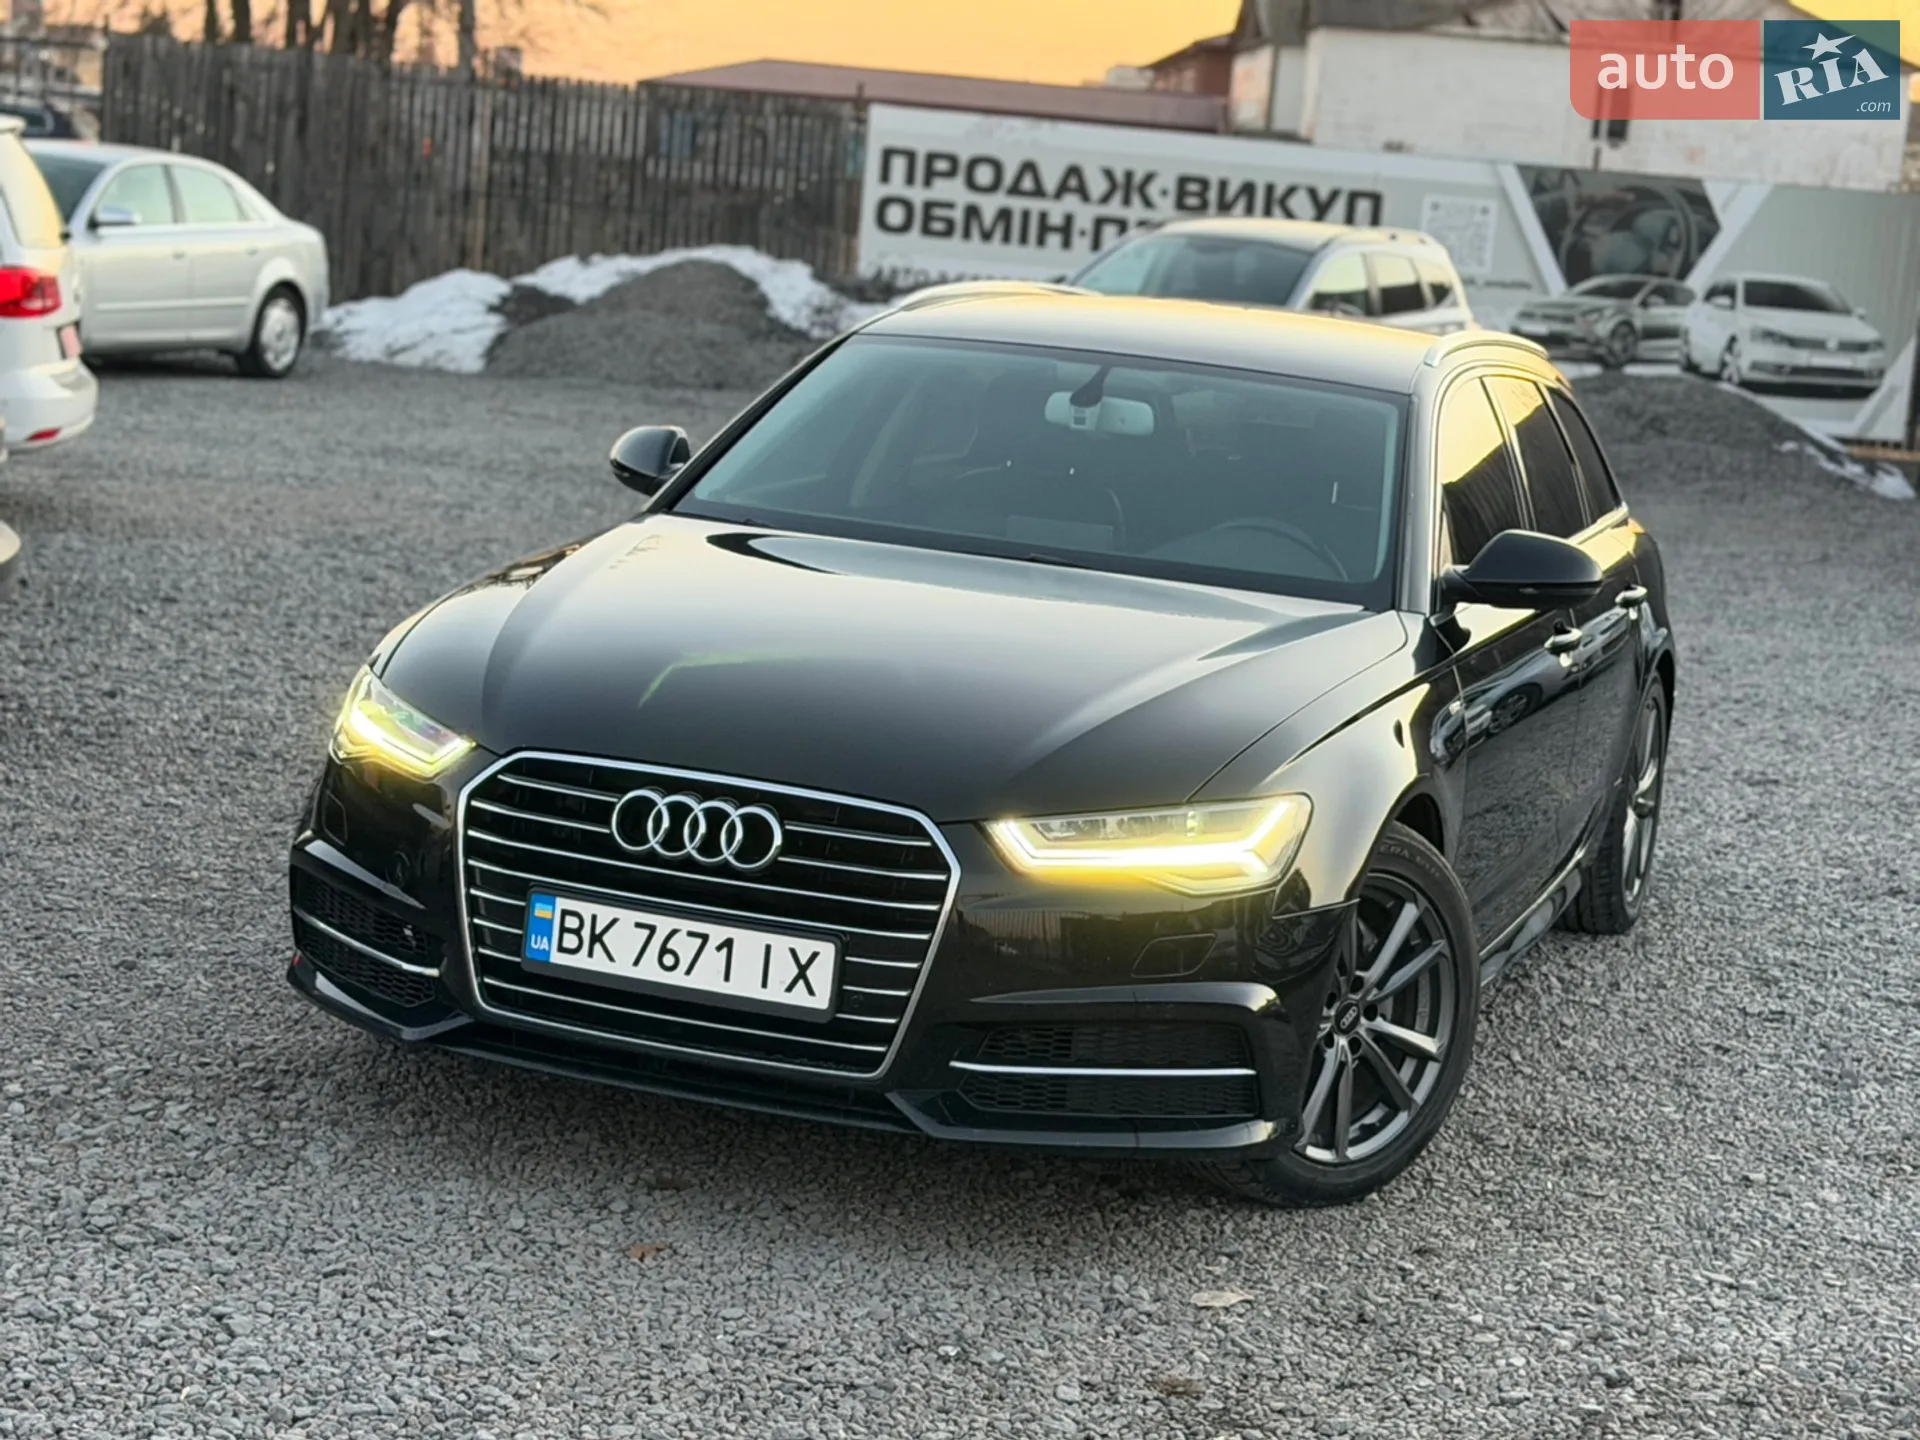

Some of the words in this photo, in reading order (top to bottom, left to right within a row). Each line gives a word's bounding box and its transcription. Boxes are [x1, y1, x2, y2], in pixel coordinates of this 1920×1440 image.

[530, 934, 550, 951] UA
[556, 908, 620, 963] BK
[631, 921, 735, 983] 7671
[760, 943, 821, 997] IX
